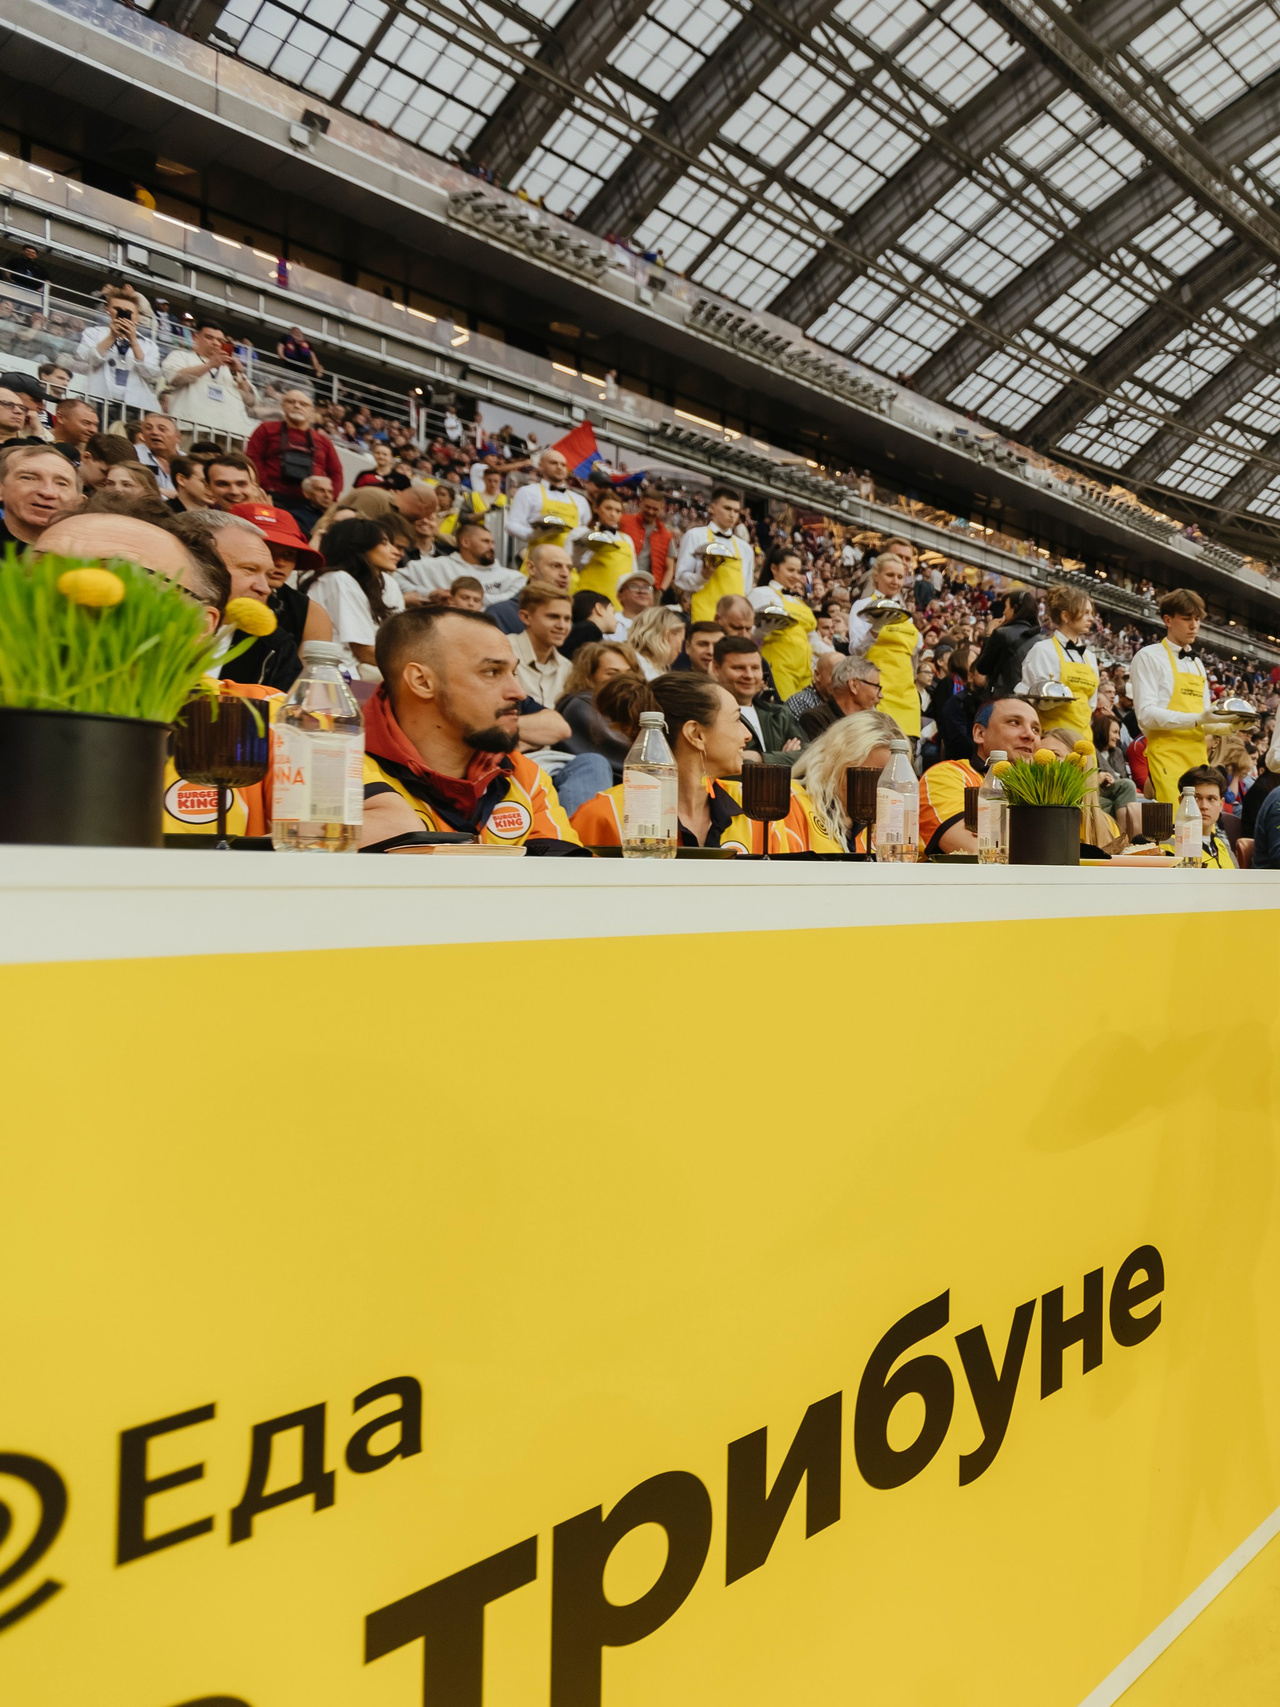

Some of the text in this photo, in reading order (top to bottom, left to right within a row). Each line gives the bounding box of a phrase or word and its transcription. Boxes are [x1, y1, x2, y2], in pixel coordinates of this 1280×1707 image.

[273, 766, 306, 786] NNA
[177, 797, 218, 809] KING
[492, 812, 522, 821] BURGER
[494, 818, 524, 829] KING
[115, 1375, 423, 1568] Еда
[364, 1244, 1165, 1707] трибуне
